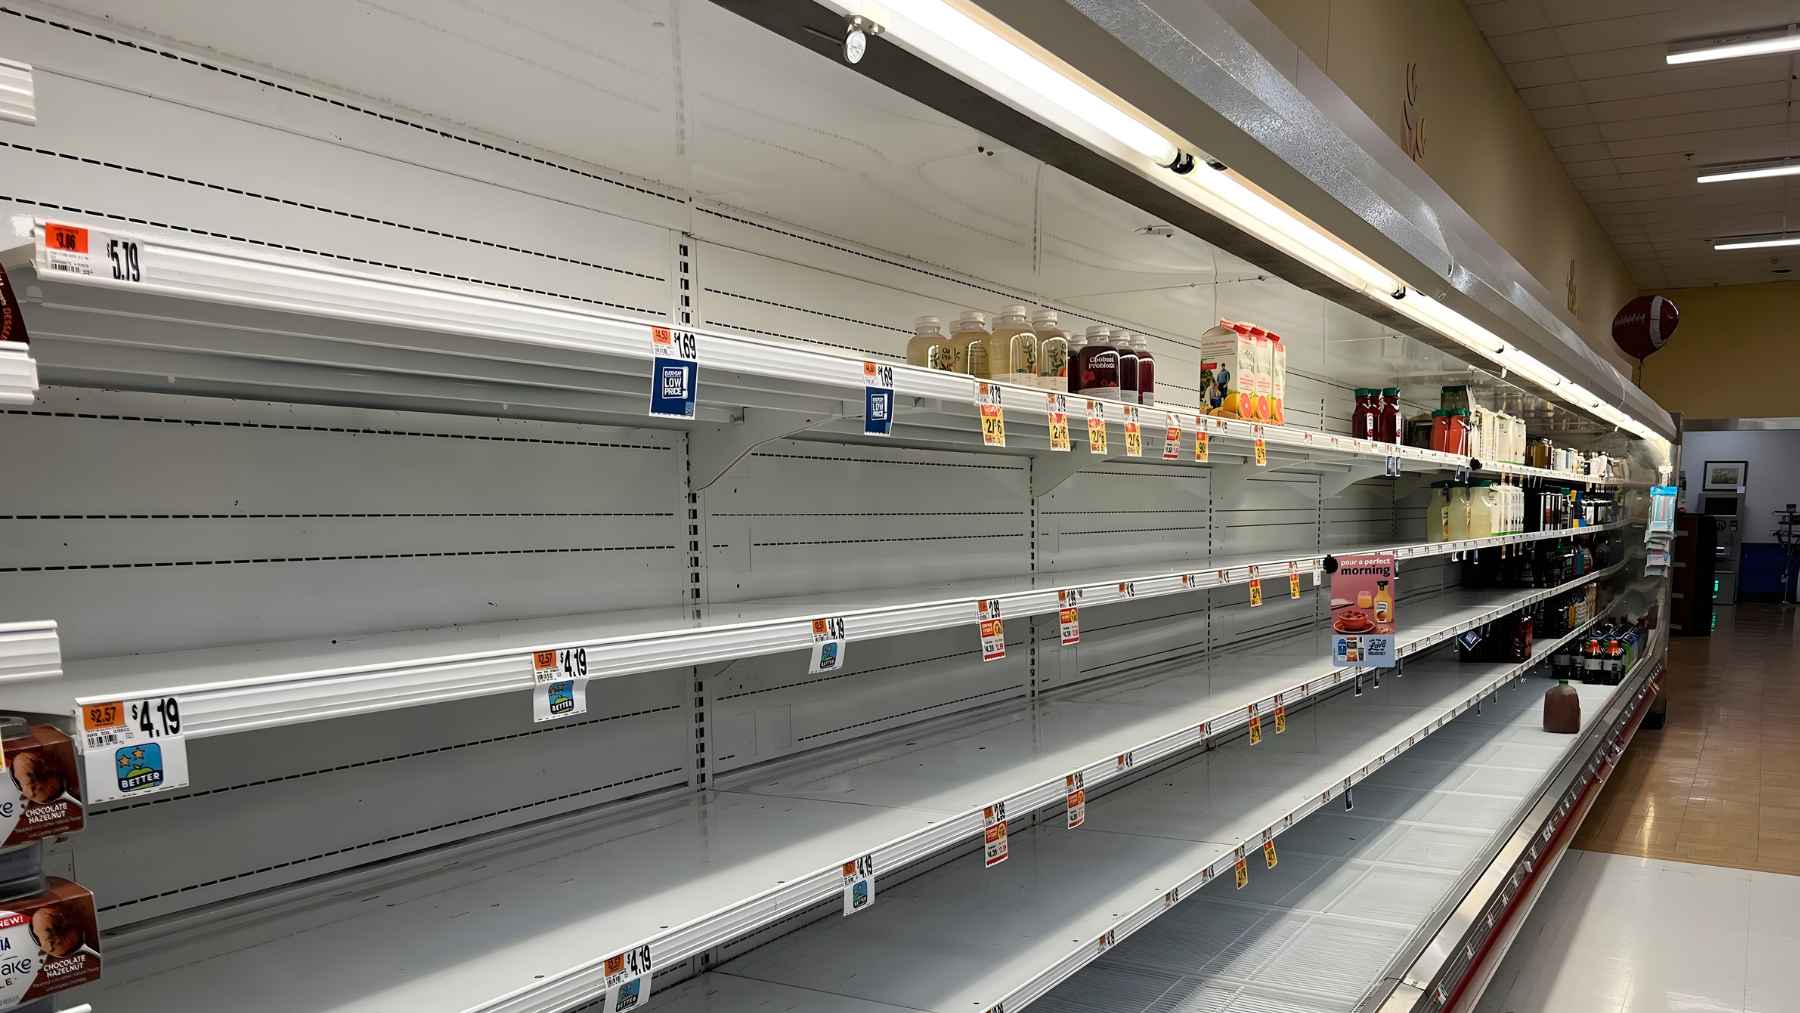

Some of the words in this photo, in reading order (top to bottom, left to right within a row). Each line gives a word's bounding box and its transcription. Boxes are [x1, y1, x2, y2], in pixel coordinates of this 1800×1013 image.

[107, 239, 140, 282] $5.79
[674, 331, 697, 360] $1.69
[664, 378, 682, 388] LOW
[664, 387, 682, 397] PRICE
[1341, 565, 1391, 577] morning
[1365, 558, 1391, 568] perfect
[561, 648, 587, 677] $4.19
[90, 706, 116, 723] $2.57
[131, 698, 180, 738] $4.19
[121, 772, 161, 788] BETTER
[25, 803, 68, 818] CHOCOLATE
[28, 811, 66, 824] HAZELNUT
[43, 955, 86, 972] CHOCOLATE
[627, 945, 651, 975] $4.19
[46, 963, 84, 978] HAZELNUT
